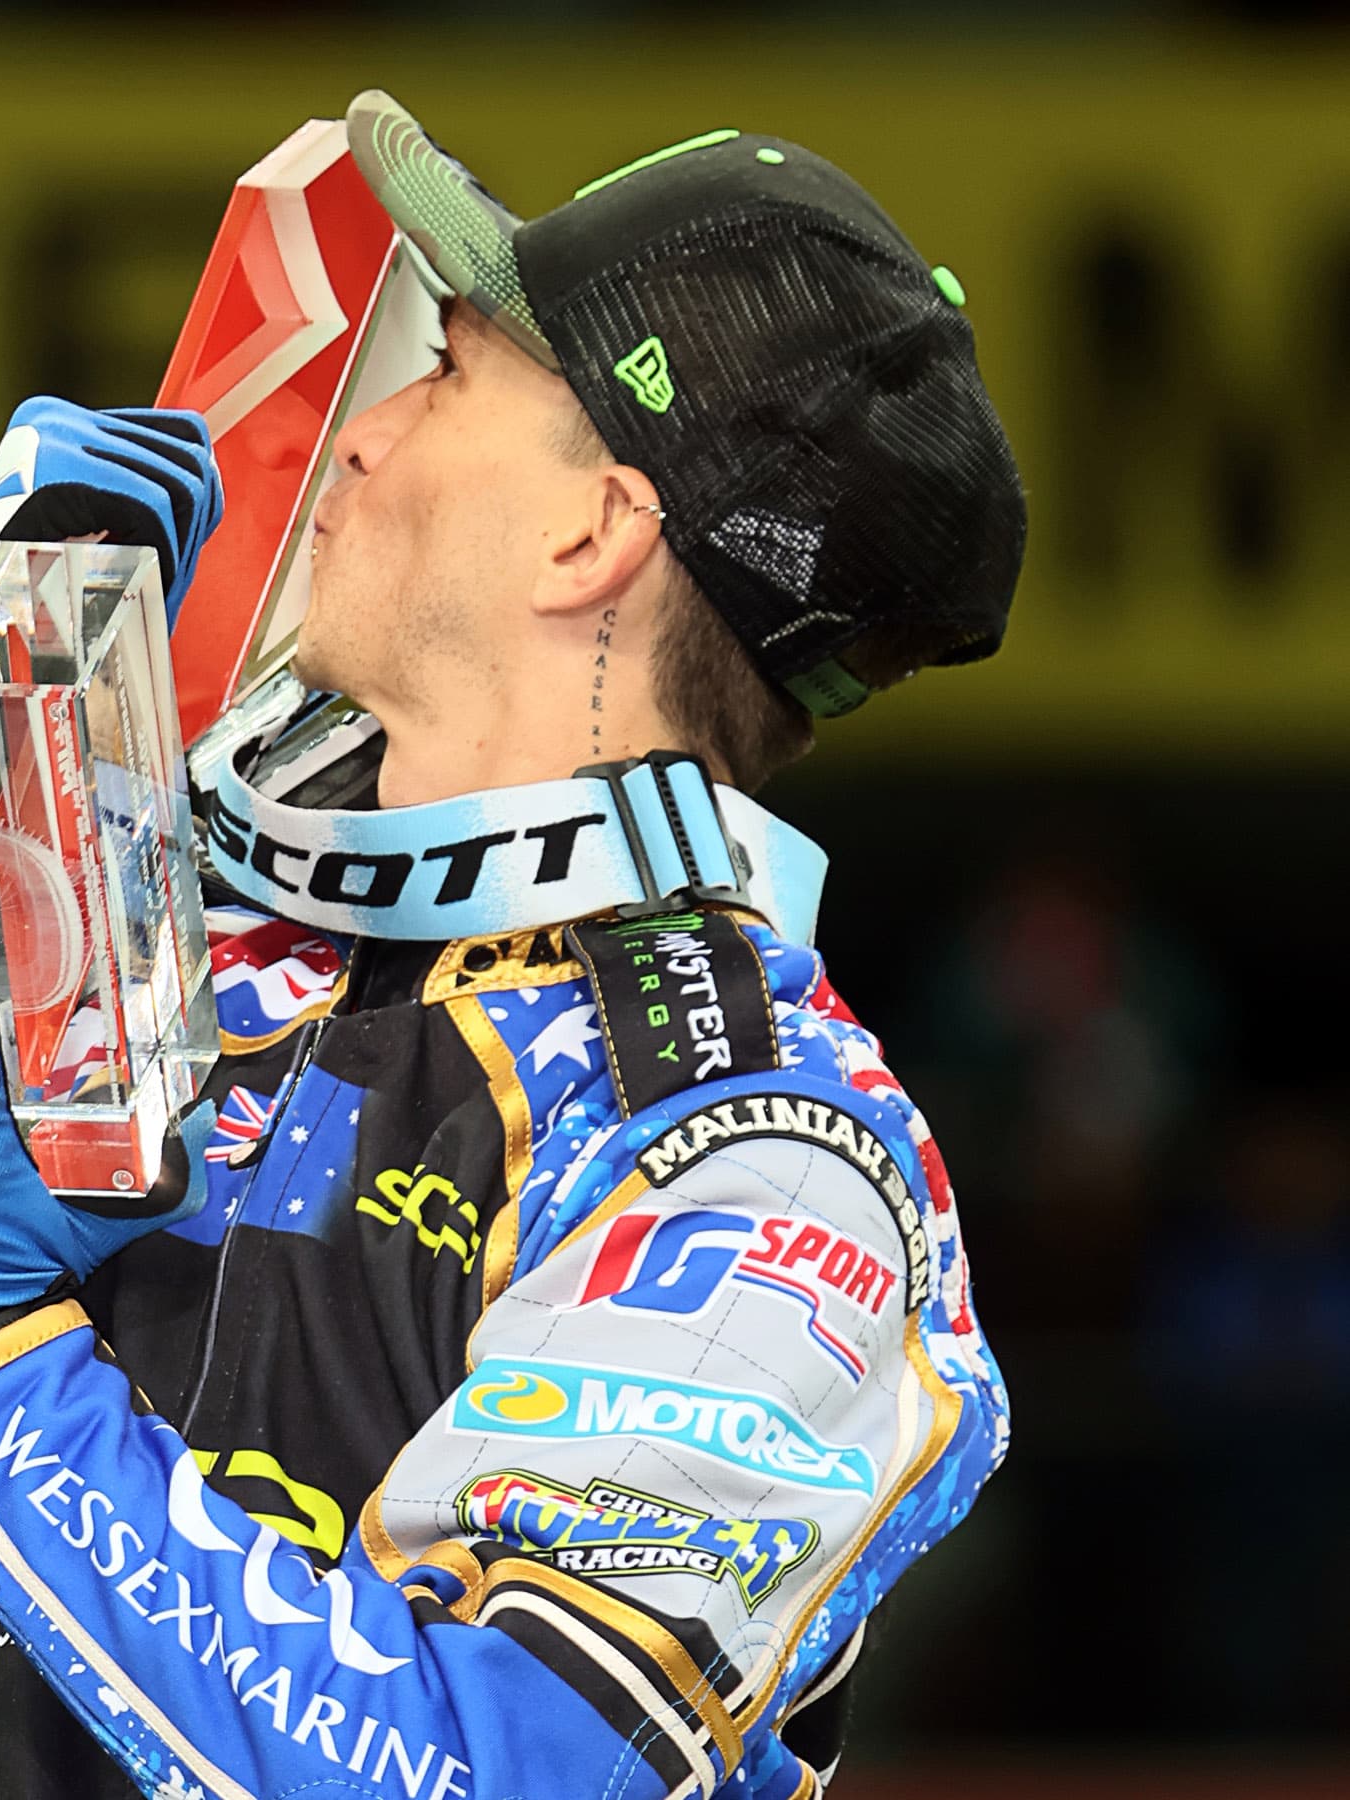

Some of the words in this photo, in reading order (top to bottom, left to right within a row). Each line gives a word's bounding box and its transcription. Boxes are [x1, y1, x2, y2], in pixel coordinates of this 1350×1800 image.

[590, 608, 617, 712] CHASE
[208, 787, 607, 908] SCOTT
[640, 1096, 888, 1180] MALINIAK
[745, 1218, 897, 1316] SPORT
[574, 1378, 865, 1483] MOTOREX
[467, 1474, 811, 1598] HOLDER
[556, 1546, 718, 1572] RACING
